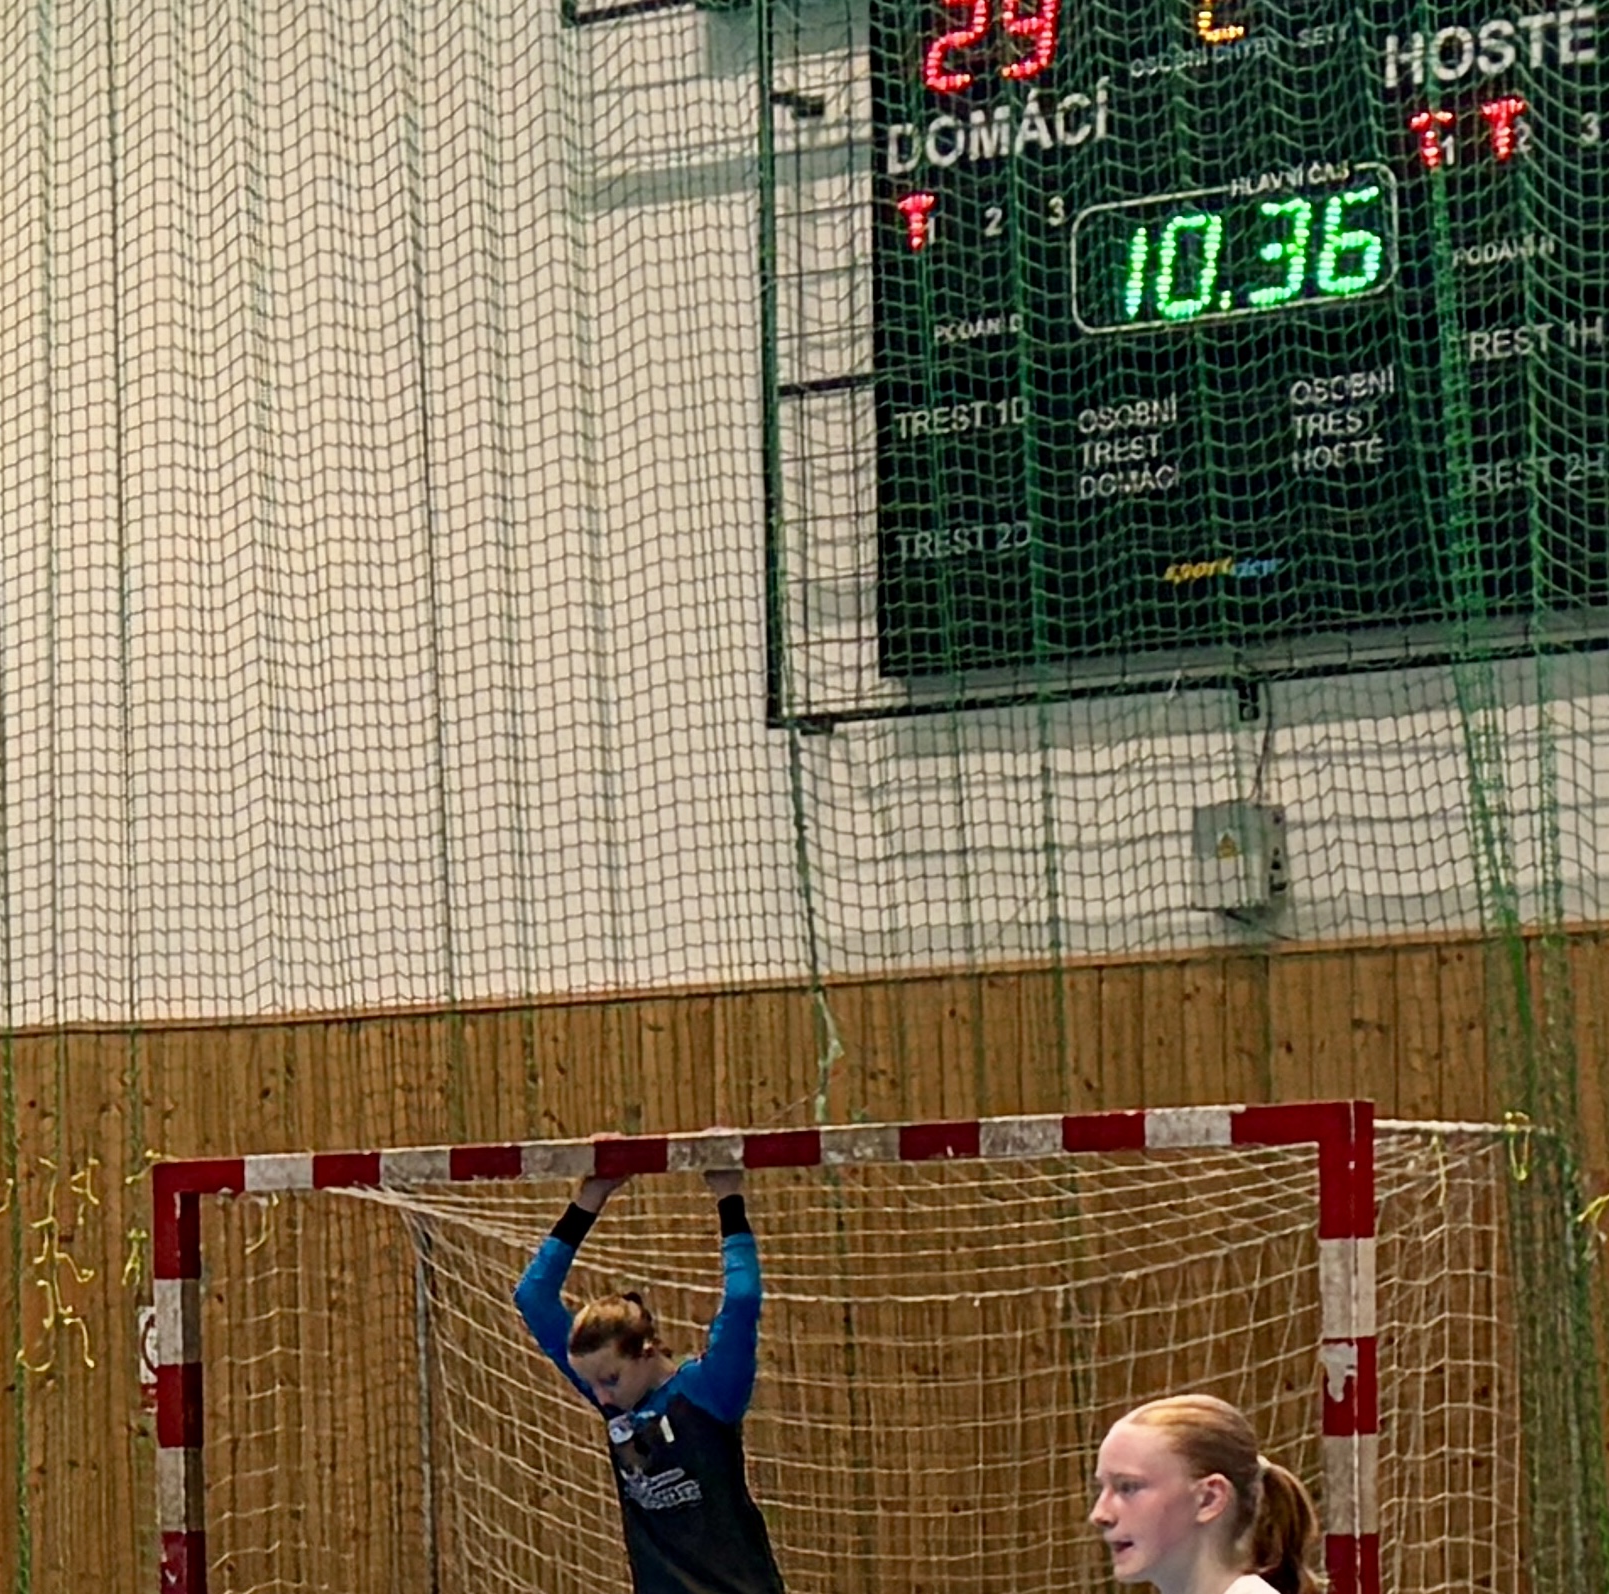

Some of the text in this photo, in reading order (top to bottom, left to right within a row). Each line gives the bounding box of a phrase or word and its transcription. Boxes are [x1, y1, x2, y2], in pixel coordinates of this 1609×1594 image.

[923, 0, 1059, 93] 29
[886, 76, 1110, 175] DOMÁCÍ
[1581, 112, 1601, 145] 3
[985, 207, 1003, 237] 2
[1049, 196, 1065, 227] 3
[1125, 186, 1383, 320] 10.36
[893, 396, 1030, 440] TREST 1D
[1293, 404, 1379, 440] TREST
[1082, 434, 1162, 468] TREST
[893, 526, 987, 563] TREST
